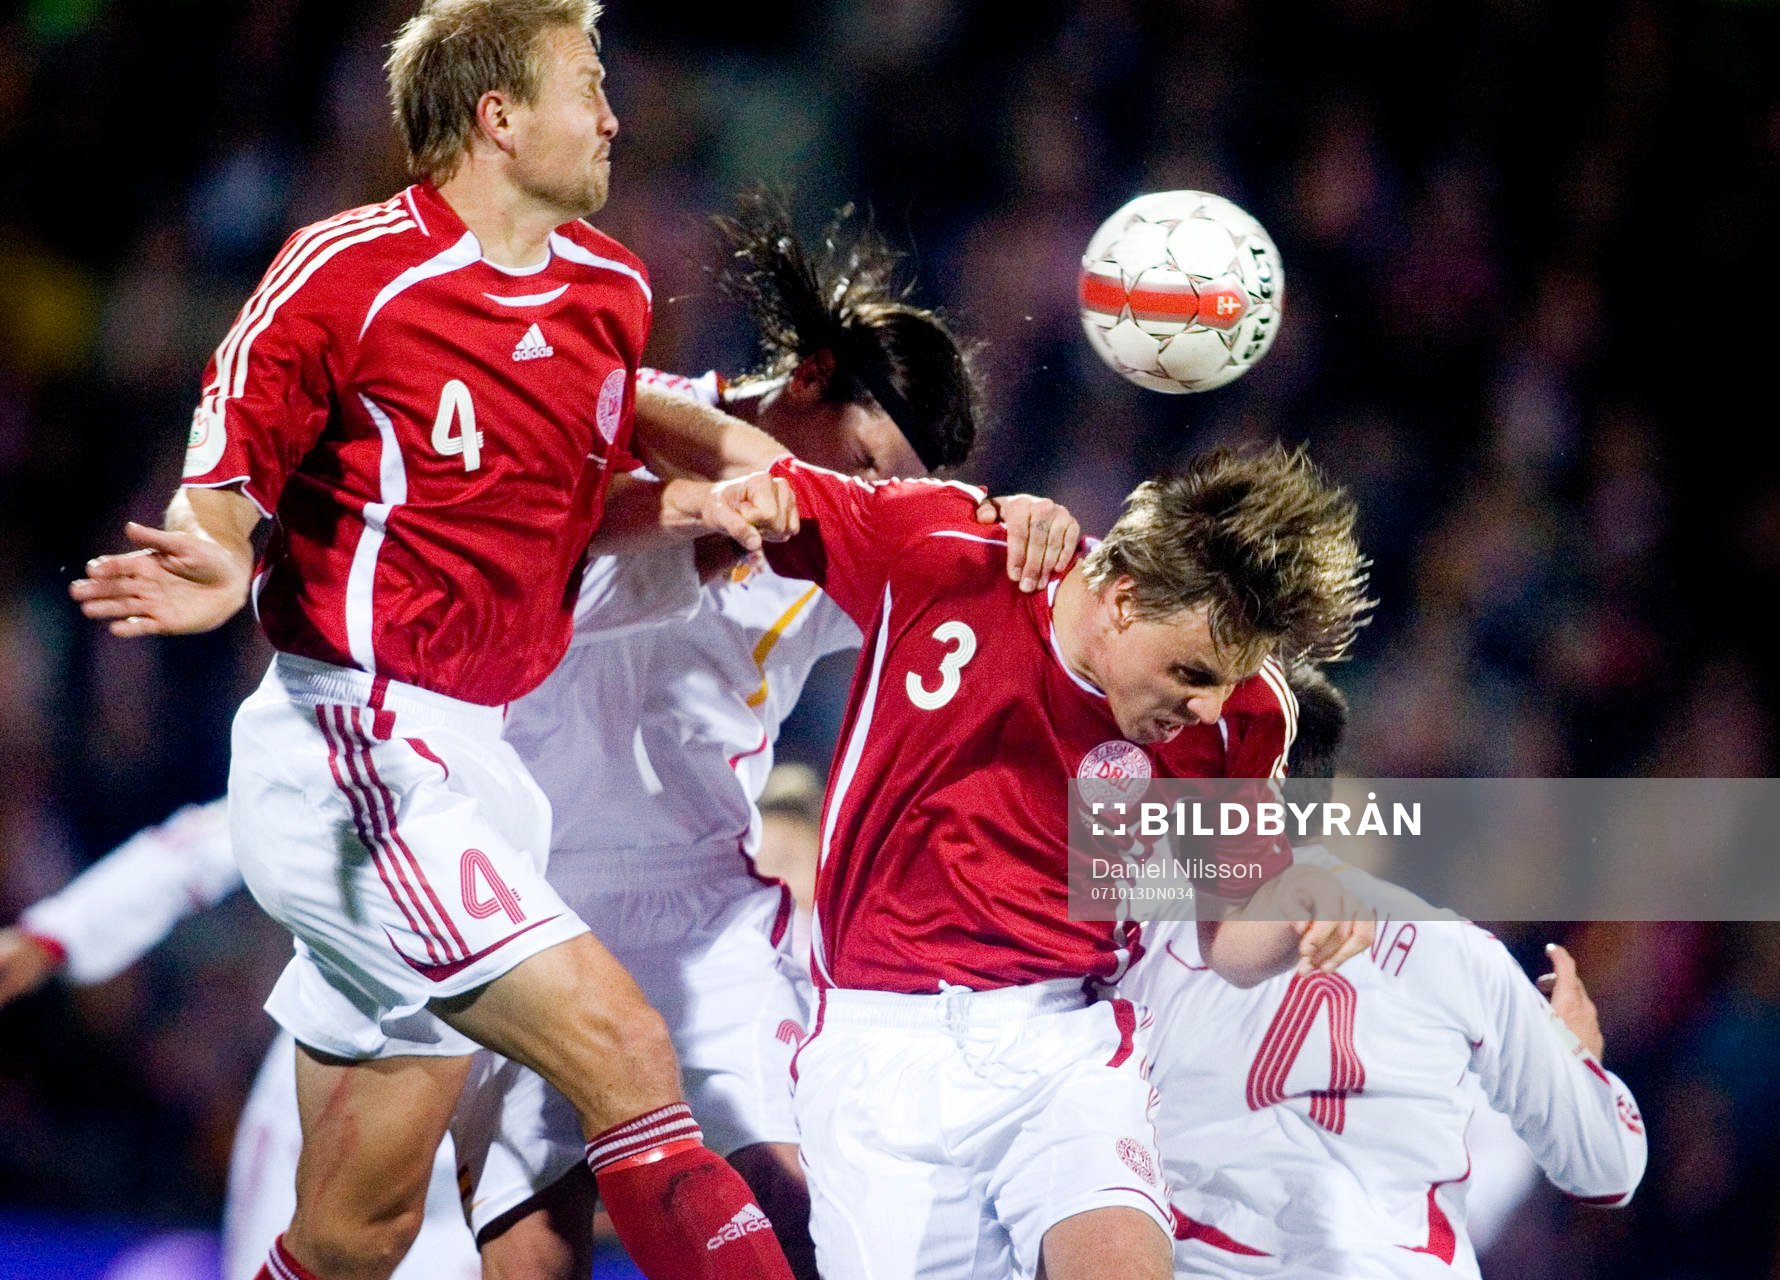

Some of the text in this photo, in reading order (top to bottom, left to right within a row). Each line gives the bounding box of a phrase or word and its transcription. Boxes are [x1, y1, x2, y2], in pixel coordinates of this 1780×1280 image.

[512, 346, 553, 361] adidas
[431, 379, 484, 472] 4
[906, 621, 976, 710] 3
[460, 848, 527, 925] 4
[1246, 970, 1365, 1135] 4
[706, 1217, 772, 1250] adida
